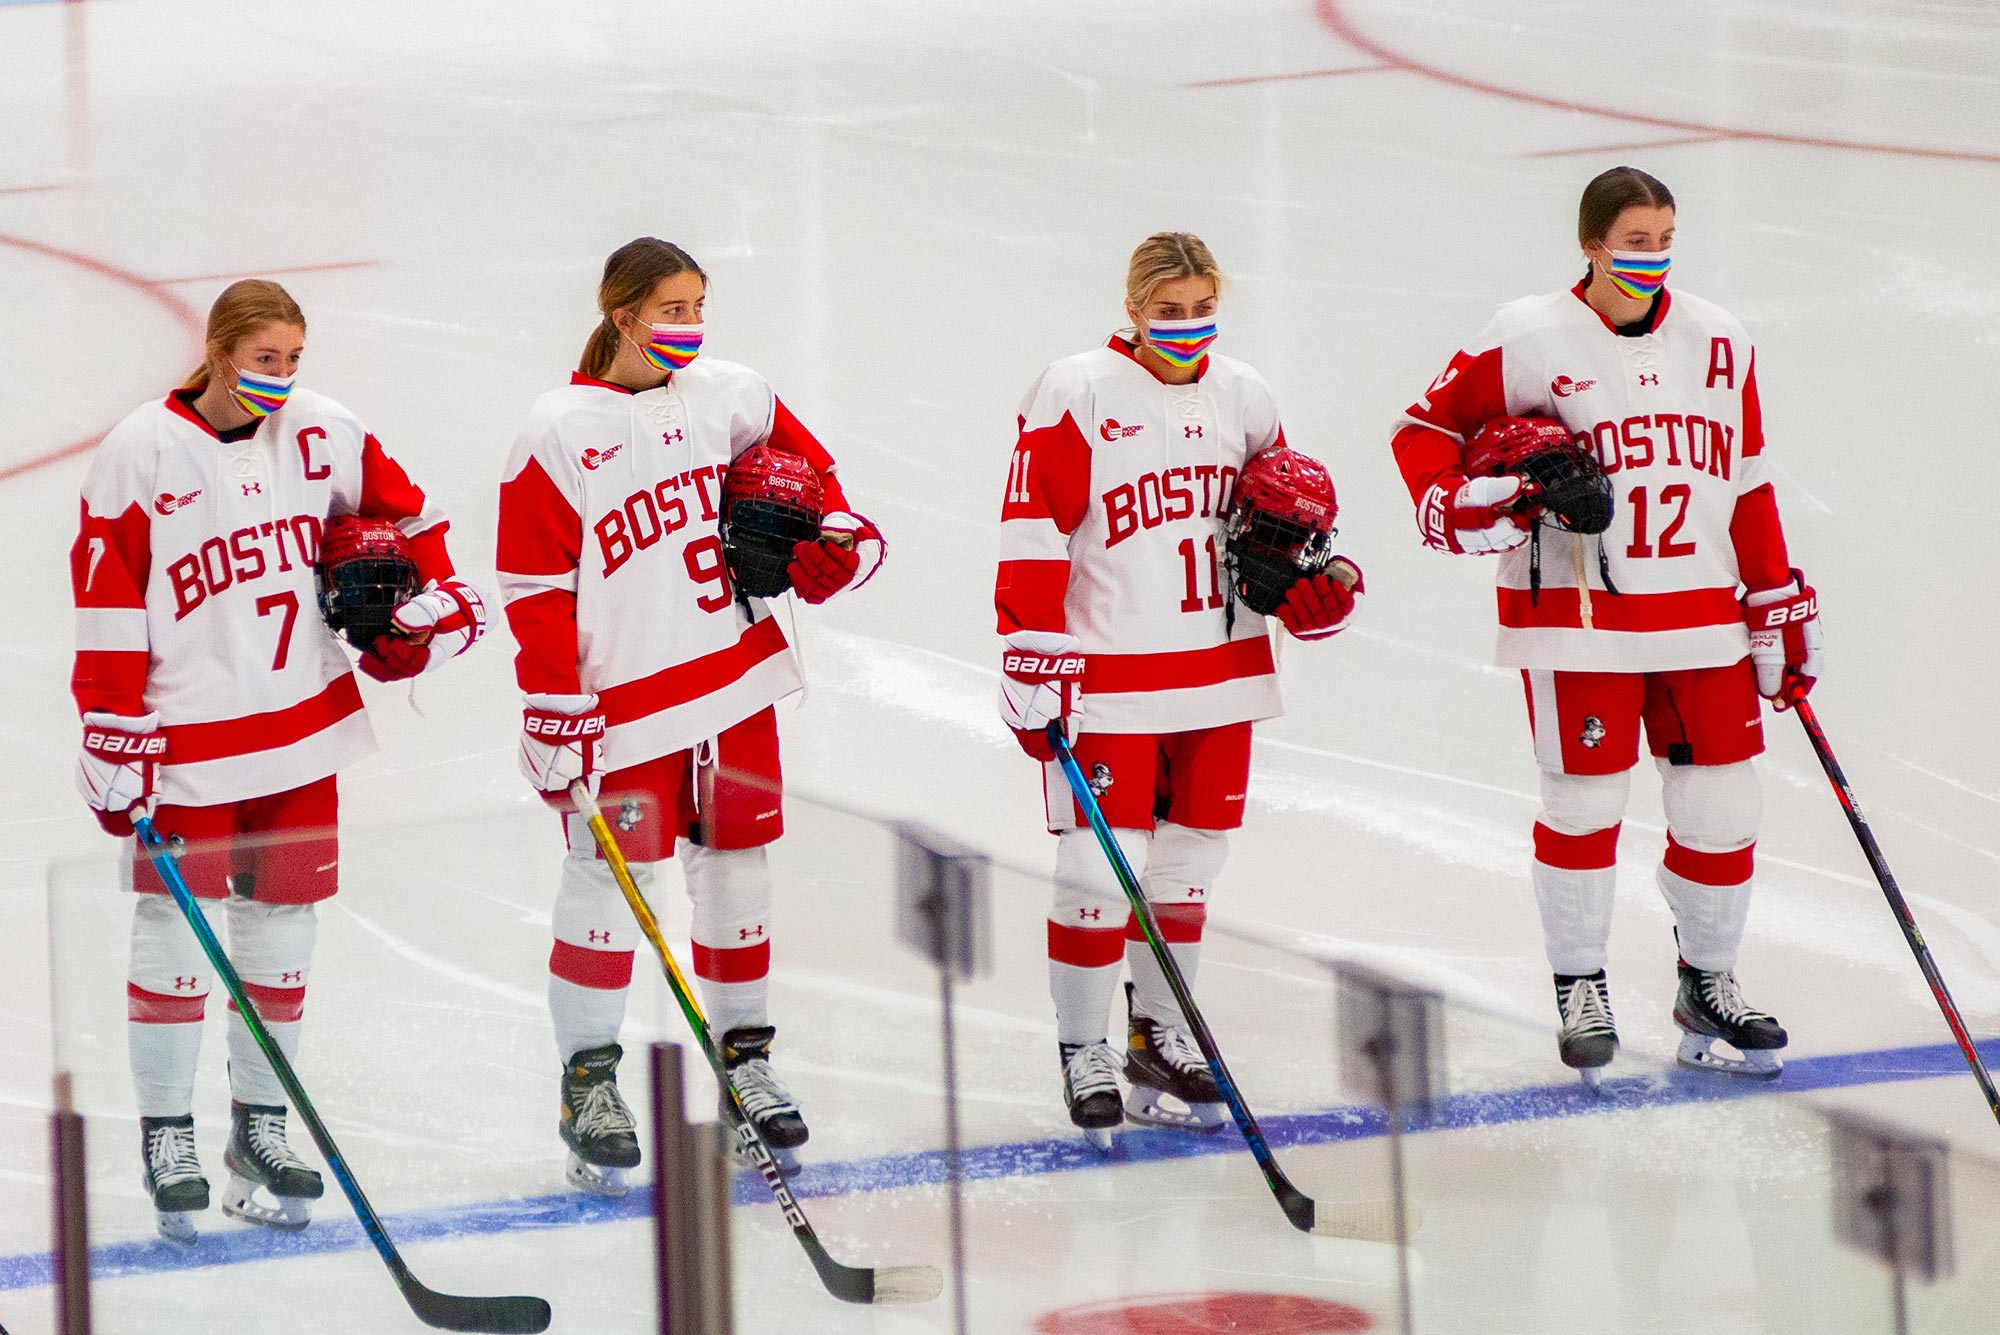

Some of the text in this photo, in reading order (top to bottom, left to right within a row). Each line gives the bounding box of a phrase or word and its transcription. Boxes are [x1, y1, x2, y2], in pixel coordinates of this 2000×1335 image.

[1706, 337, 1734, 389] A
[296, 426, 331, 480] C
[1537, 425, 1566, 436] BOSTON
[769, 474, 803, 492] BOSTON
[1009, 450, 1031, 503] 11
[594, 463, 729, 580] BOST
[1102, 465, 1238, 550] BOSTO
[1294, 496, 1327, 517] BOSTON
[1428, 486, 1449, 550] UER
[1626, 484, 1696, 558] 12
[362, 531, 395, 541] BOSTON
[85, 537, 106, 593] 7
[166, 514, 326, 622] BOSTO
[683, 535, 733, 614] 9
[1178, 534, 1224, 613] 11
[255, 590, 300, 672] 7
[454, 586, 487, 641] BAU
[1765, 597, 1819, 627] BAU
[1005, 656, 1085, 675] BAUER
[86, 732, 168, 754] BAUER
[525, 715, 606, 736] BAUER
[737, 1122, 806, 1228] BAUER
